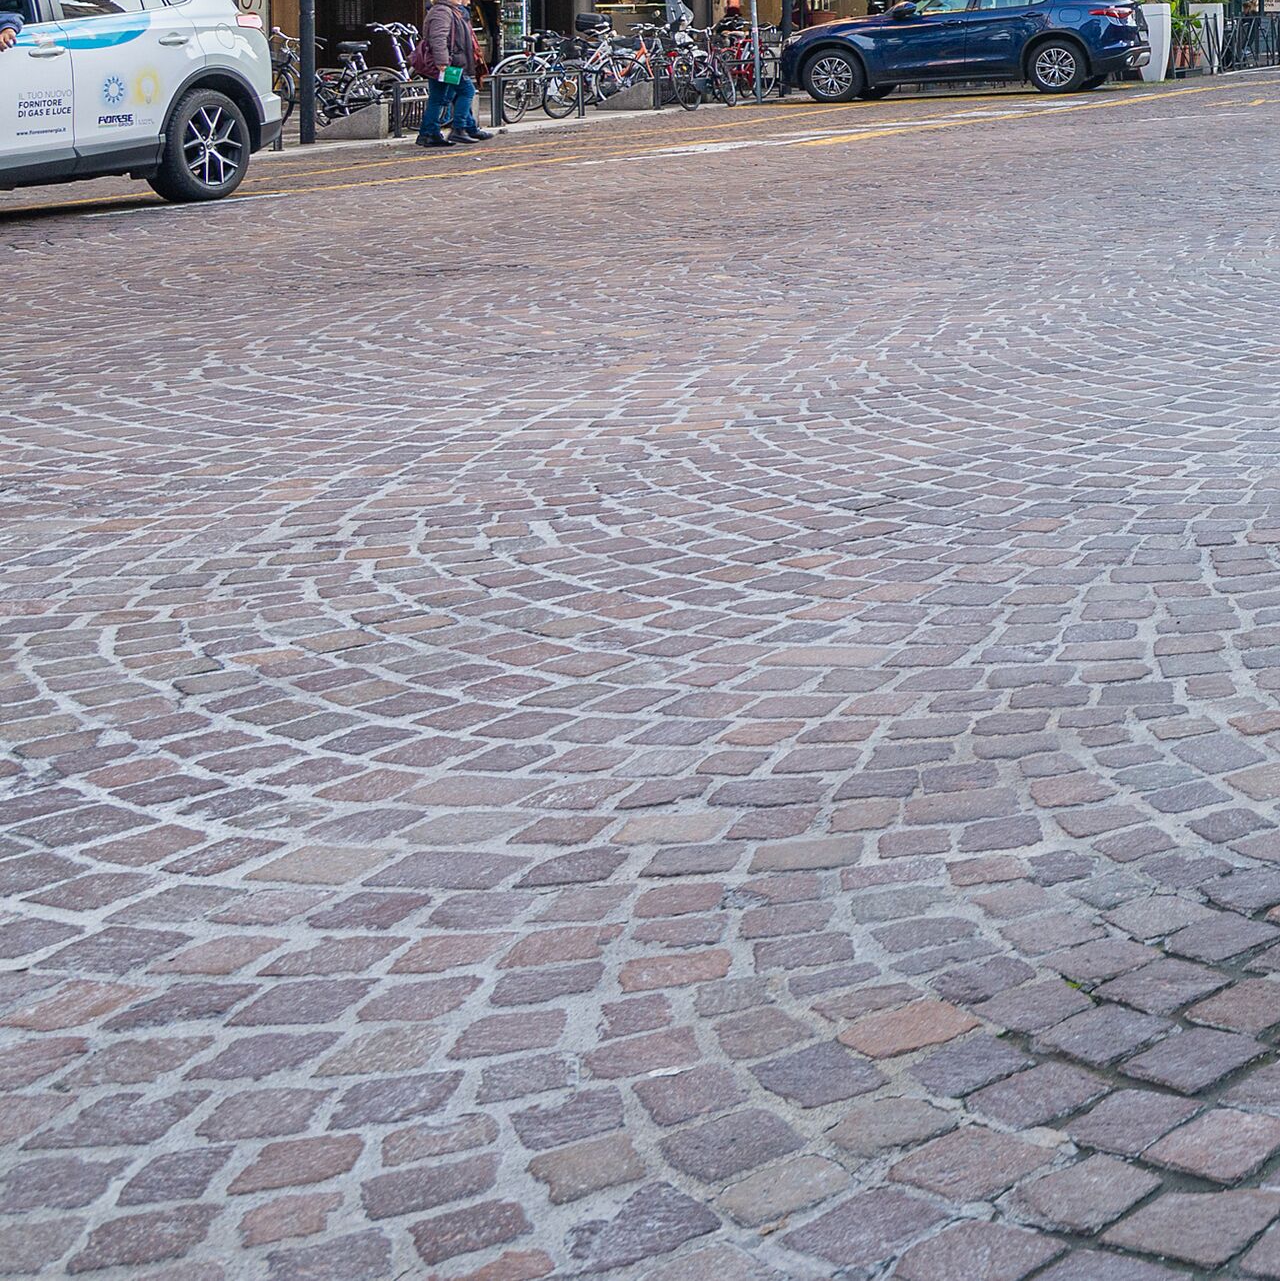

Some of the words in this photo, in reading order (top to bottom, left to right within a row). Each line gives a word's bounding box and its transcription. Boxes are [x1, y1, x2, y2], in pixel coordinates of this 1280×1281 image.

[18, 98, 63, 109] FORNITORE
[18, 110, 27, 118] DI
[28, 108, 44, 117] GAS
[45, 108, 51, 116] E
[52, 106, 72, 116] LUCE
